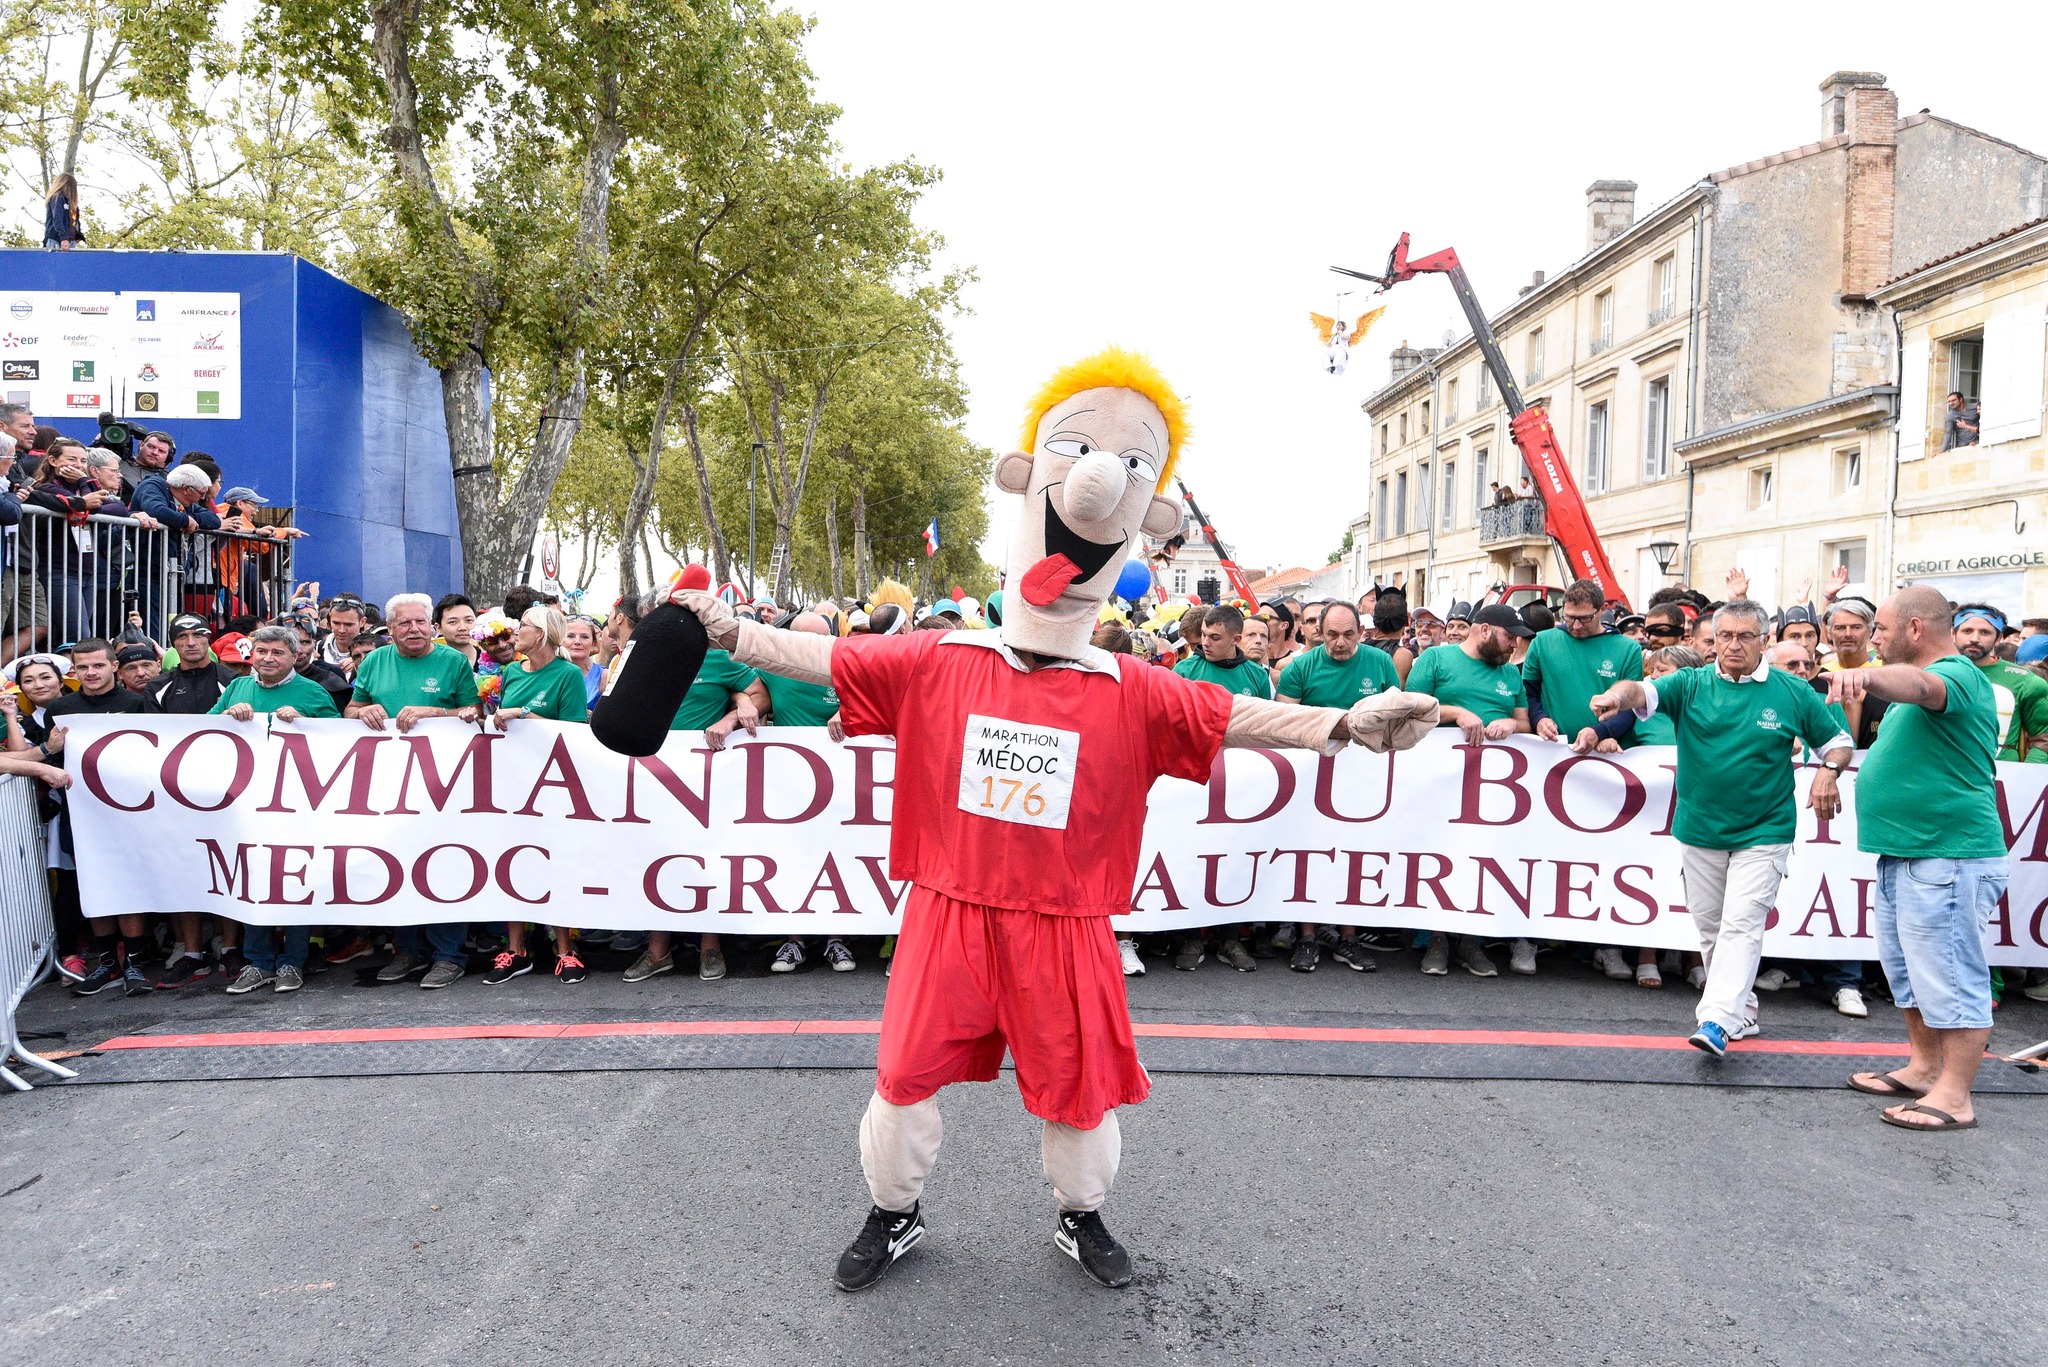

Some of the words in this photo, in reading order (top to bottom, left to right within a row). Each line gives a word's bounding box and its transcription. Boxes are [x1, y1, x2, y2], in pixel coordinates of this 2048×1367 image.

[136, 310, 153, 320] AXA
[194, 370, 221, 378] BERGEY
[72, 395, 95, 404] RMC
[1544, 459, 1563, 494] LOXAM
[1957, 551, 2045, 569] AGRICOLE
[981, 727, 1059, 748] MARATHON
[976, 744, 1058, 775] MÉDOC
[980, 775, 1046, 817] 176
[1196, 748, 1394, 825] DU
[196, 838, 552, 906] MEDOC
[642, 853, 914, 916] GRAV
